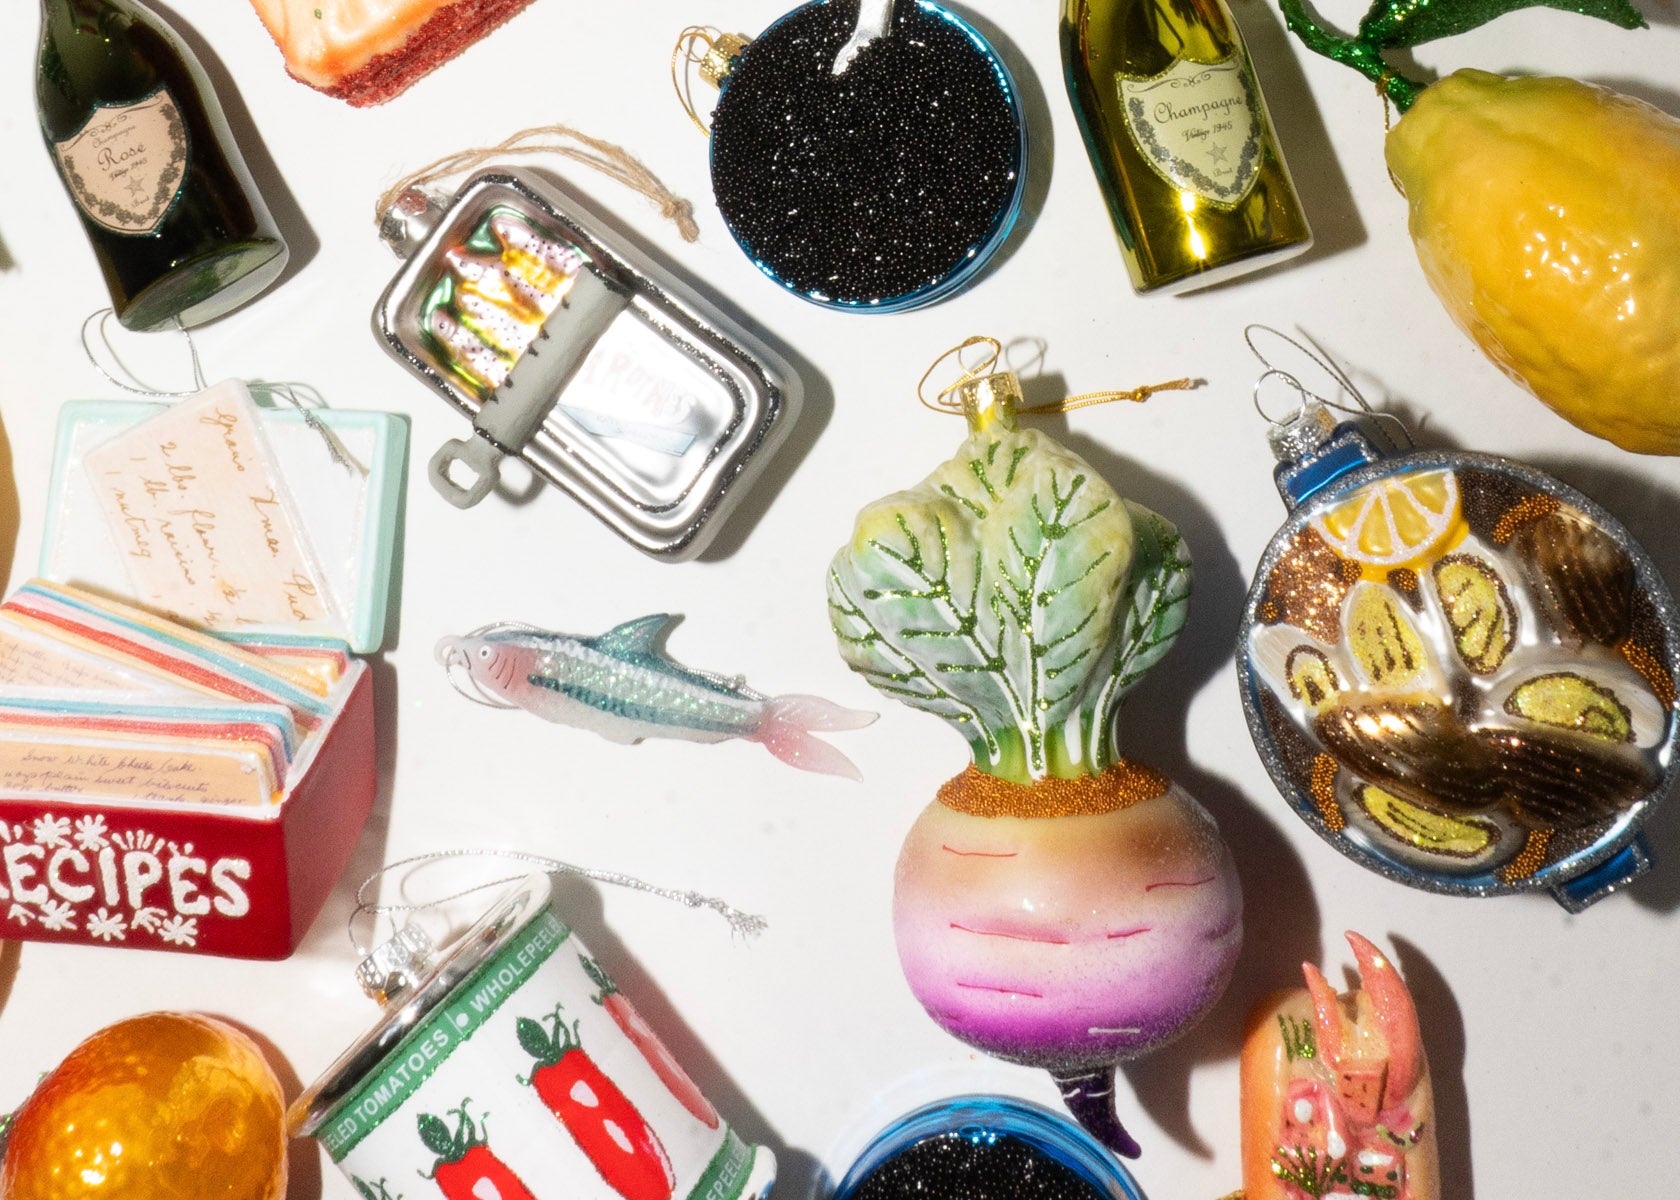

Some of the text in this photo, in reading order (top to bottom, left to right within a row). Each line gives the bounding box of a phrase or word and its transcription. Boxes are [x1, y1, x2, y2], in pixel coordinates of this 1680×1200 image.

[1153, 95, 1243, 123] Champagne
[1213, 122, 1233, 134] 1945
[97, 144, 147, 171] Rose
[160, 441, 177, 457] 2
[112, 487, 152, 560] nutmeg
[0, 843, 251, 917] ECIPES
[354, 1028, 450, 1123] TOMATOES
